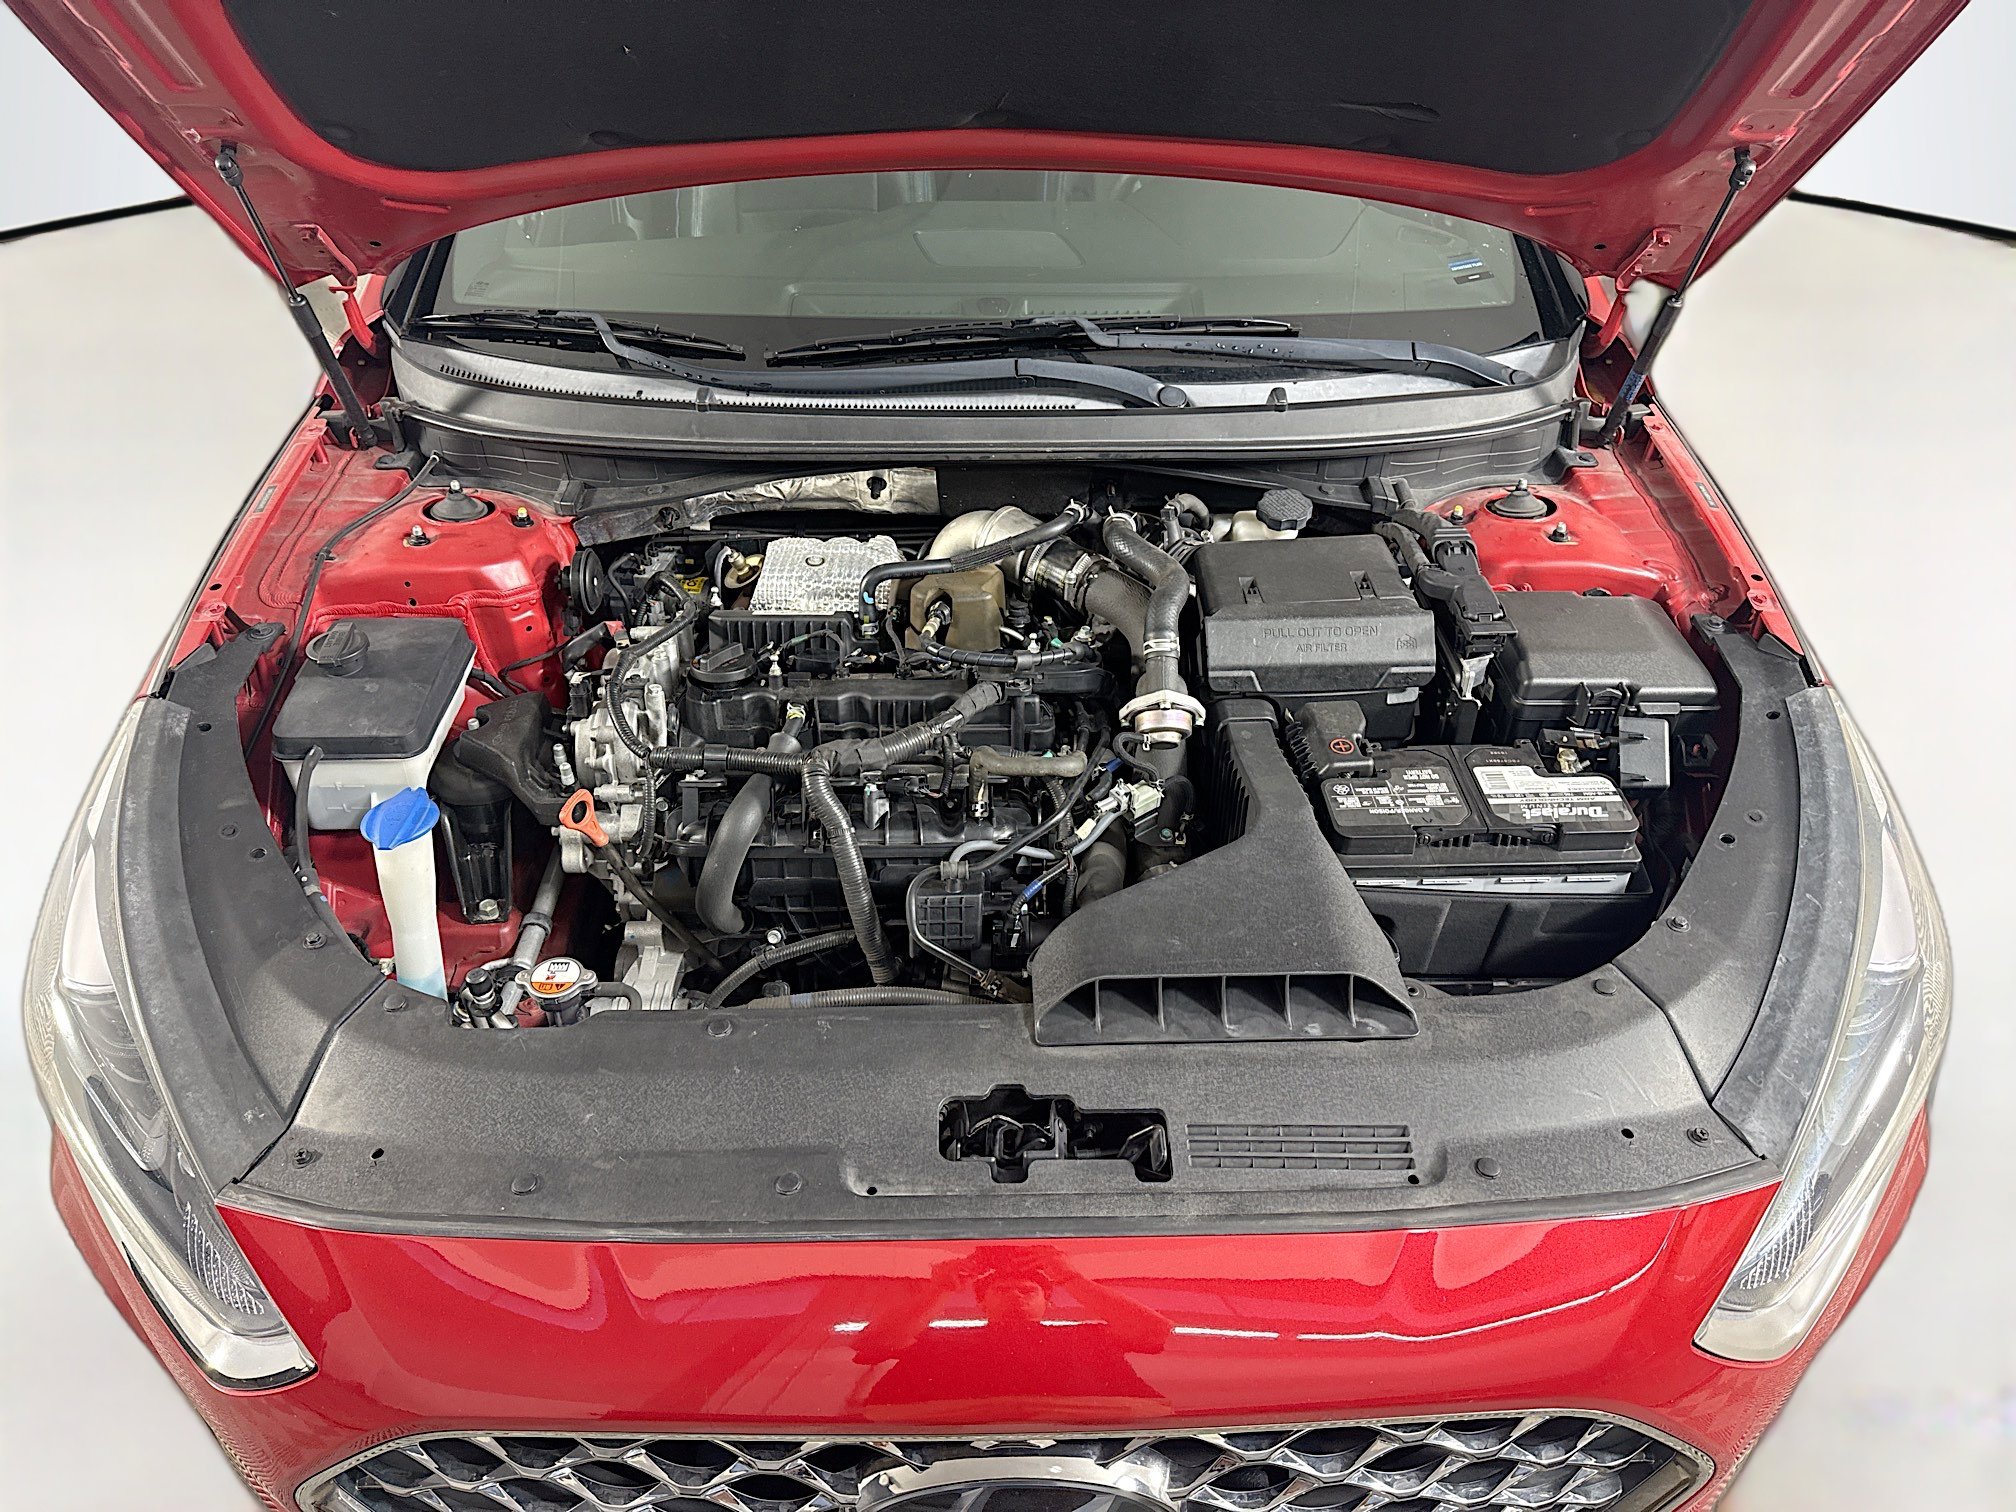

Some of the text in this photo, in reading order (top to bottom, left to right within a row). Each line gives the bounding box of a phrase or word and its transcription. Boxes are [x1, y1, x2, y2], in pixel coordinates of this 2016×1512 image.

[1263, 625, 1379, 639] PULL OUT TO OPEN
[1296, 642, 1348, 652] AIR FILTER
[1522, 806, 1609, 819] Duralast
